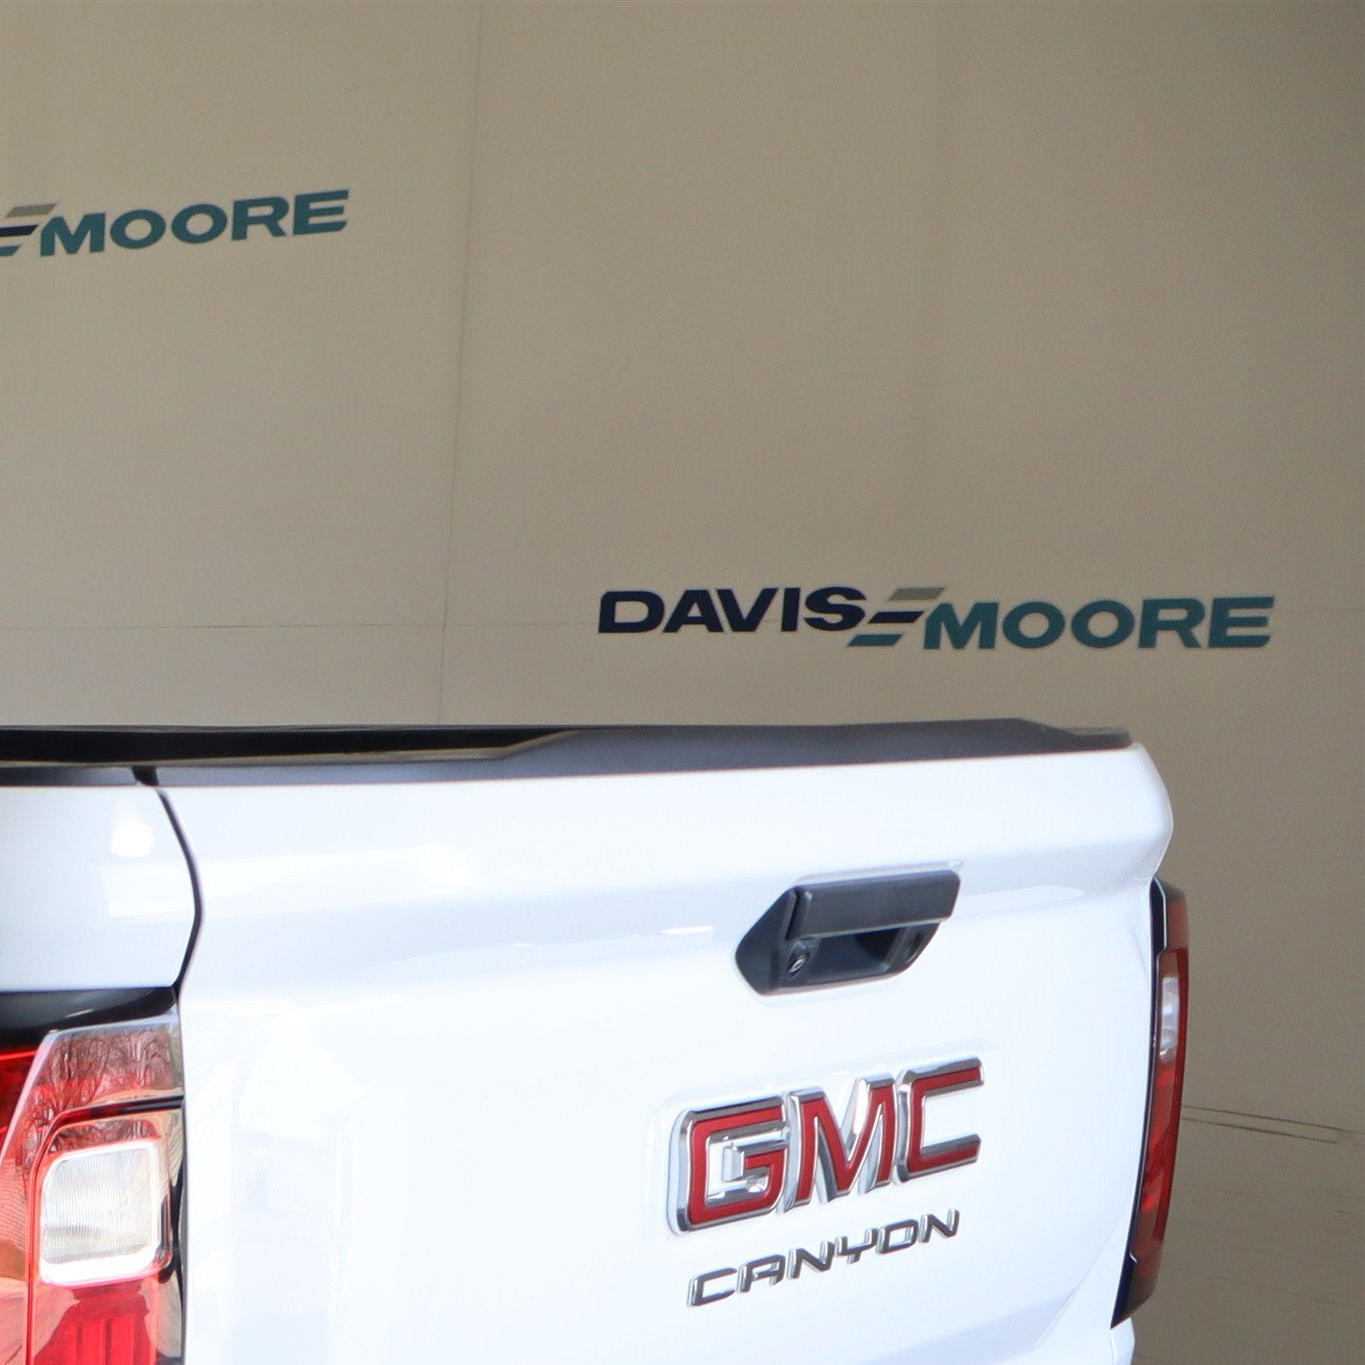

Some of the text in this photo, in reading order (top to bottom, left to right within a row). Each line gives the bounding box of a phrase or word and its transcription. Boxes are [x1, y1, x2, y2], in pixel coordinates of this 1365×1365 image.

[40, 189, 349, 257] MOORE
[597, 585, 1275, 650] DAVIS MOORE
[668, 1056, 985, 1236] GMC
[686, 1208, 960, 1307] CANYON
